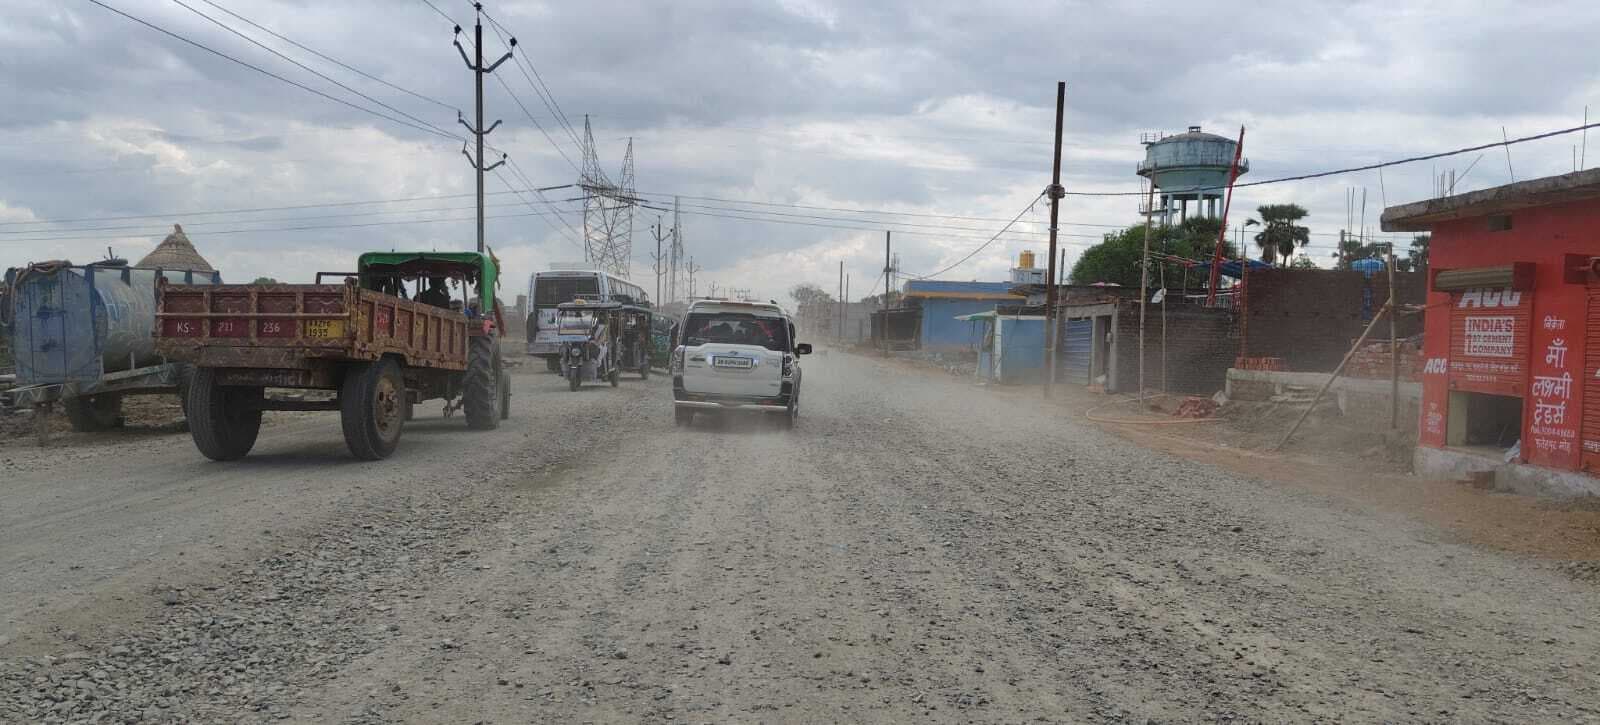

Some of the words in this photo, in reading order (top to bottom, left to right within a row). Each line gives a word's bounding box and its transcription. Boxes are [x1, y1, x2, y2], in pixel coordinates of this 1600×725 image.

[1468, 319, 1513, 333] INDIA'S
[1472, 345, 1513, 354] COMPANY
[1546, 338, 1568, 368] माँ
[1424, 358, 1447, 374] ACC
